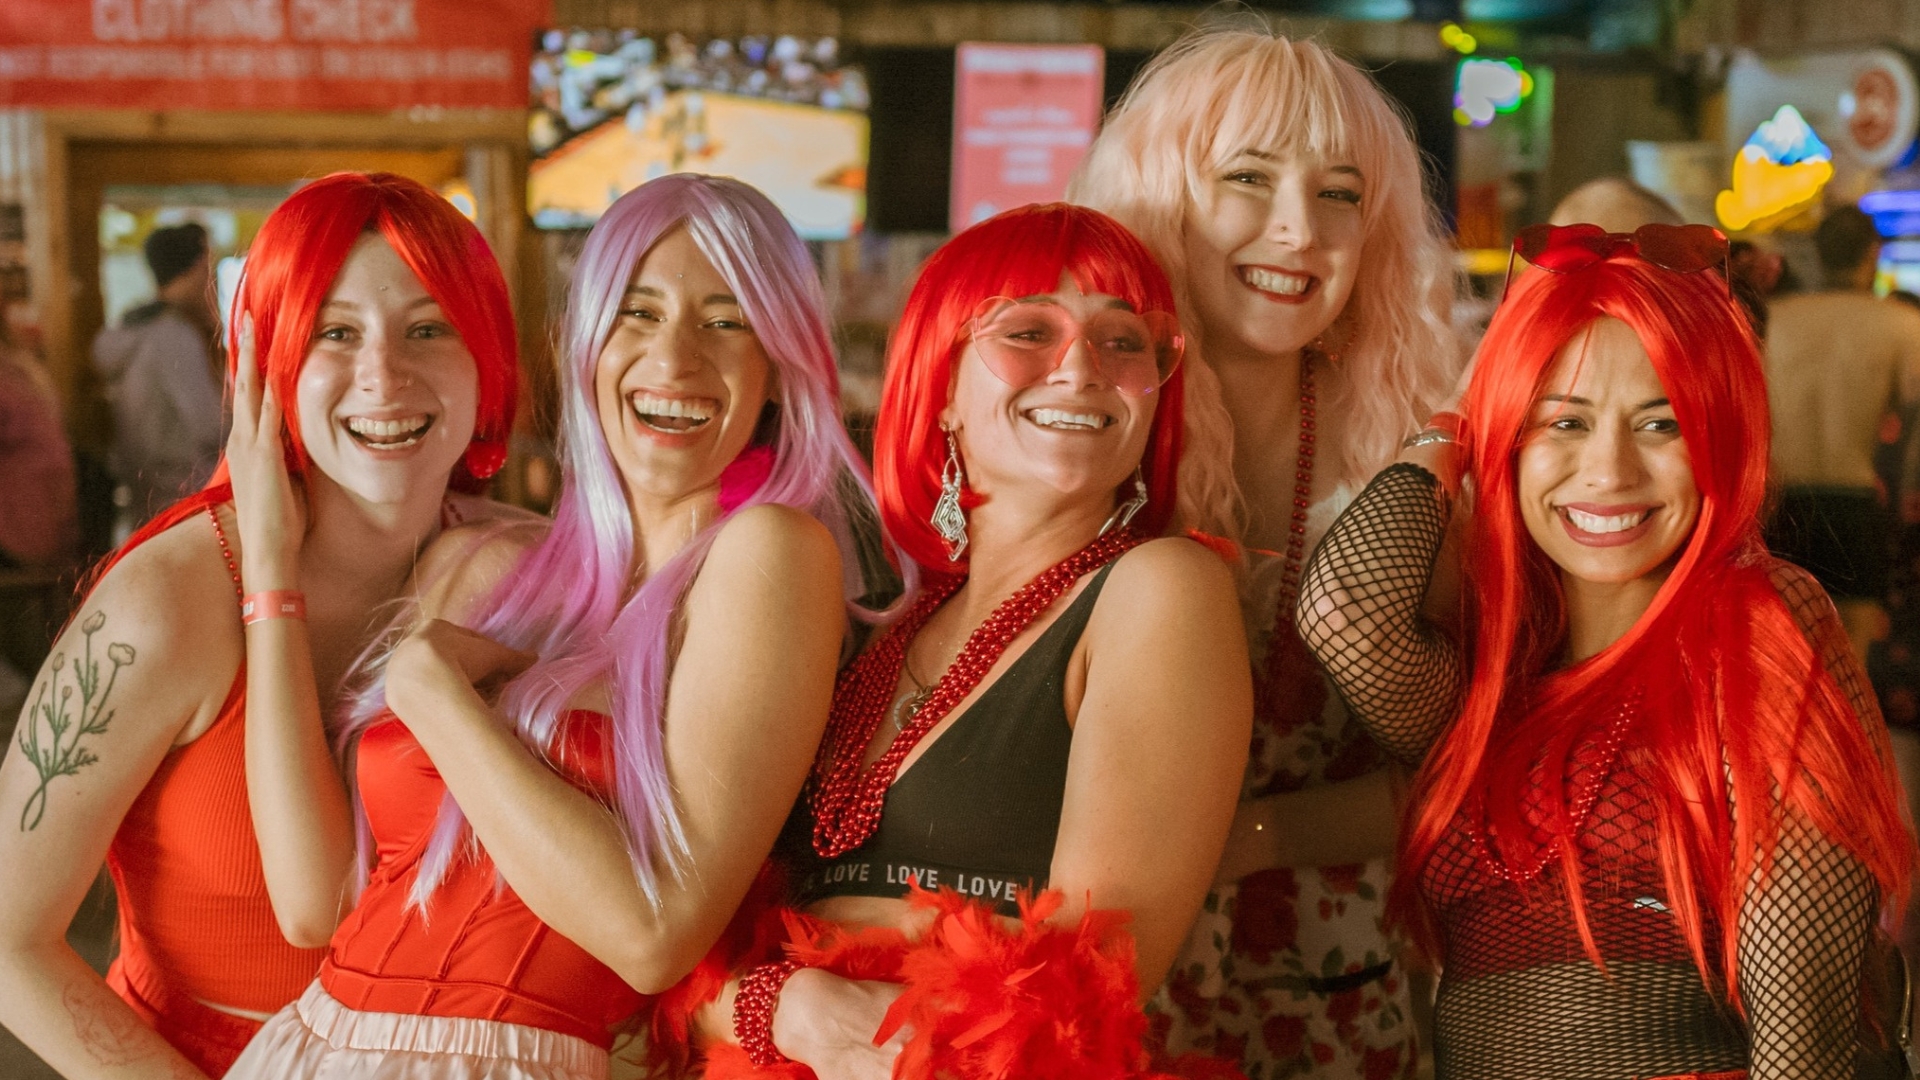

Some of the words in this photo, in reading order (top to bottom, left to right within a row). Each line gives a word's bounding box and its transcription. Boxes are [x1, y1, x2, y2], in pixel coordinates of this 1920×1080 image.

[91, 0, 284, 41] CLOTHING
[290, 0, 419, 42] CHECK
[825, 864, 871, 884] LOVE
[887, 864, 938, 889] LOVE
[958, 874, 1018, 902] LOVE
